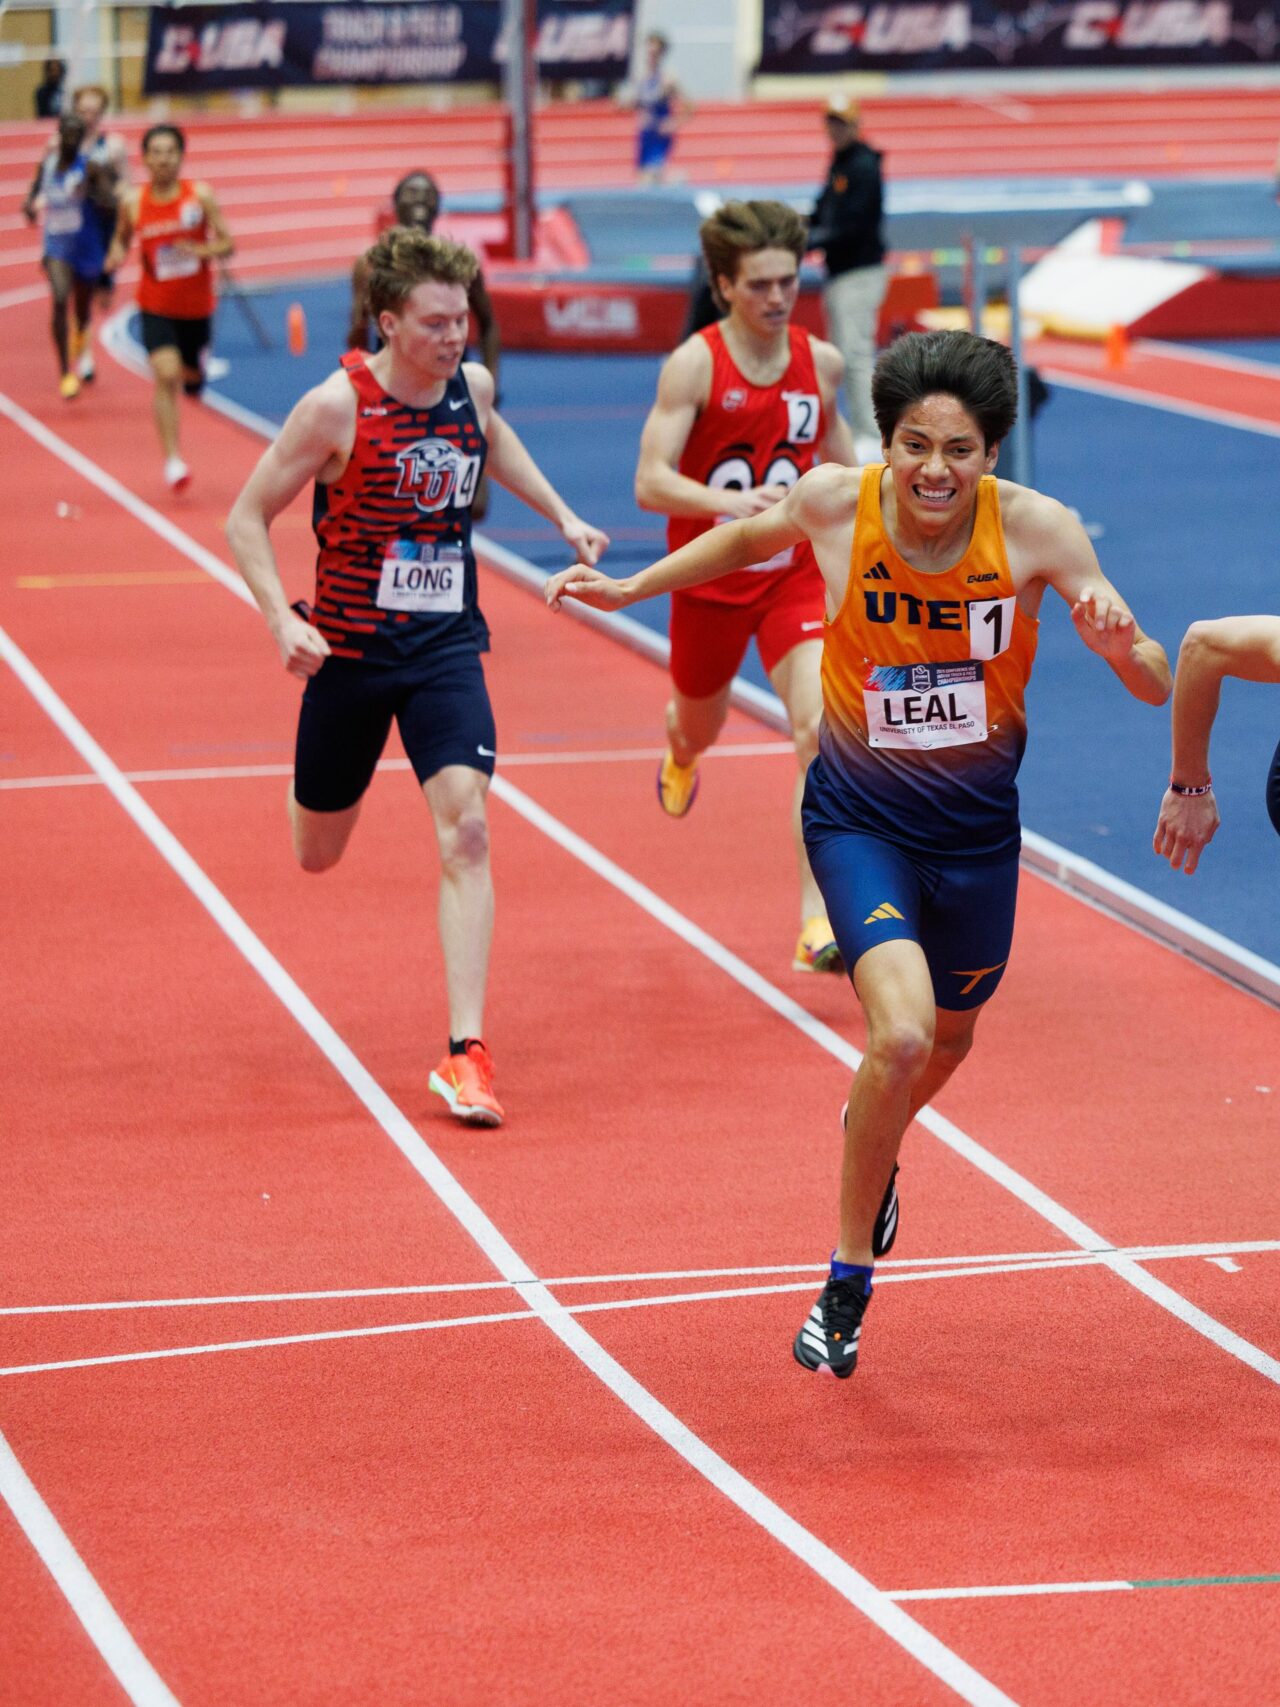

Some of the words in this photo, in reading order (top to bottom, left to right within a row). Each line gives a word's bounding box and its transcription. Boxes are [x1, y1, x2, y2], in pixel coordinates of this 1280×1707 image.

[797, 400, 812, 438] 2
[460, 461, 475, 502] 4
[392, 567, 453, 590] LONG
[864, 591, 999, 631] UTE
[983, 604, 1003, 655] 1
[883, 693, 967, 726] LEAL
[927, 723, 948, 731] TEXAS
[958, 721, 975, 729] PASO
